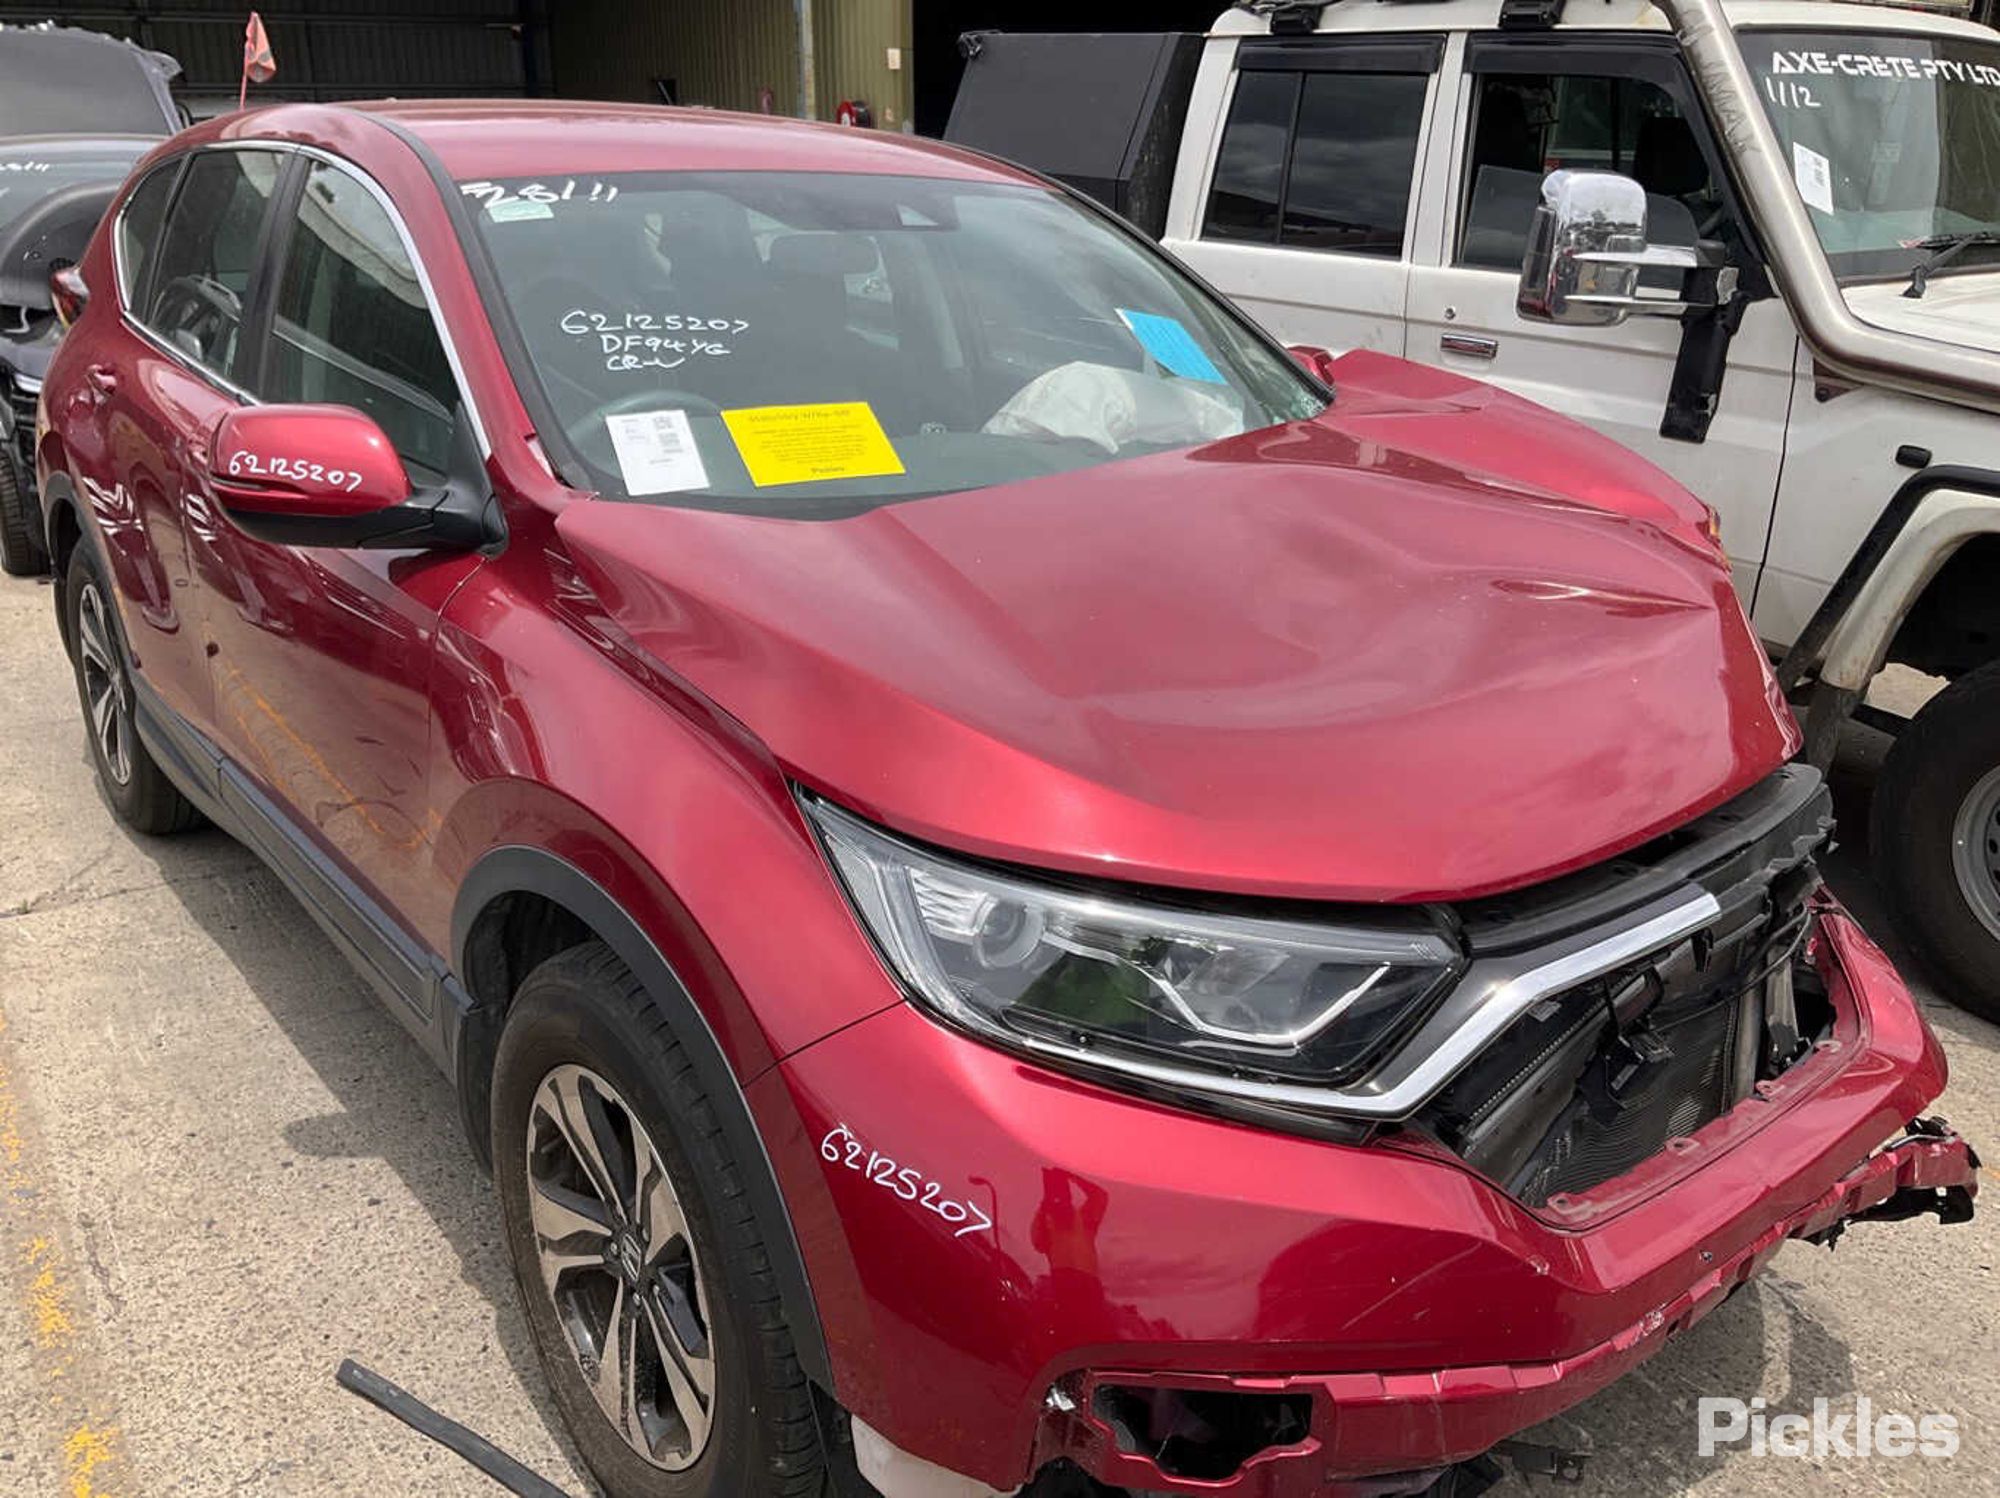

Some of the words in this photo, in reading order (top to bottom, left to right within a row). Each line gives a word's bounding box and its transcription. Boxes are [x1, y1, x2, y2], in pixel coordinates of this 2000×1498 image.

[1772, 51, 1922, 79] AXE-CRETE
[1921, 58, 1966, 82] PTY
[229, 450, 363, 493] 62125207
[821, 1122, 993, 1238] 62125207
